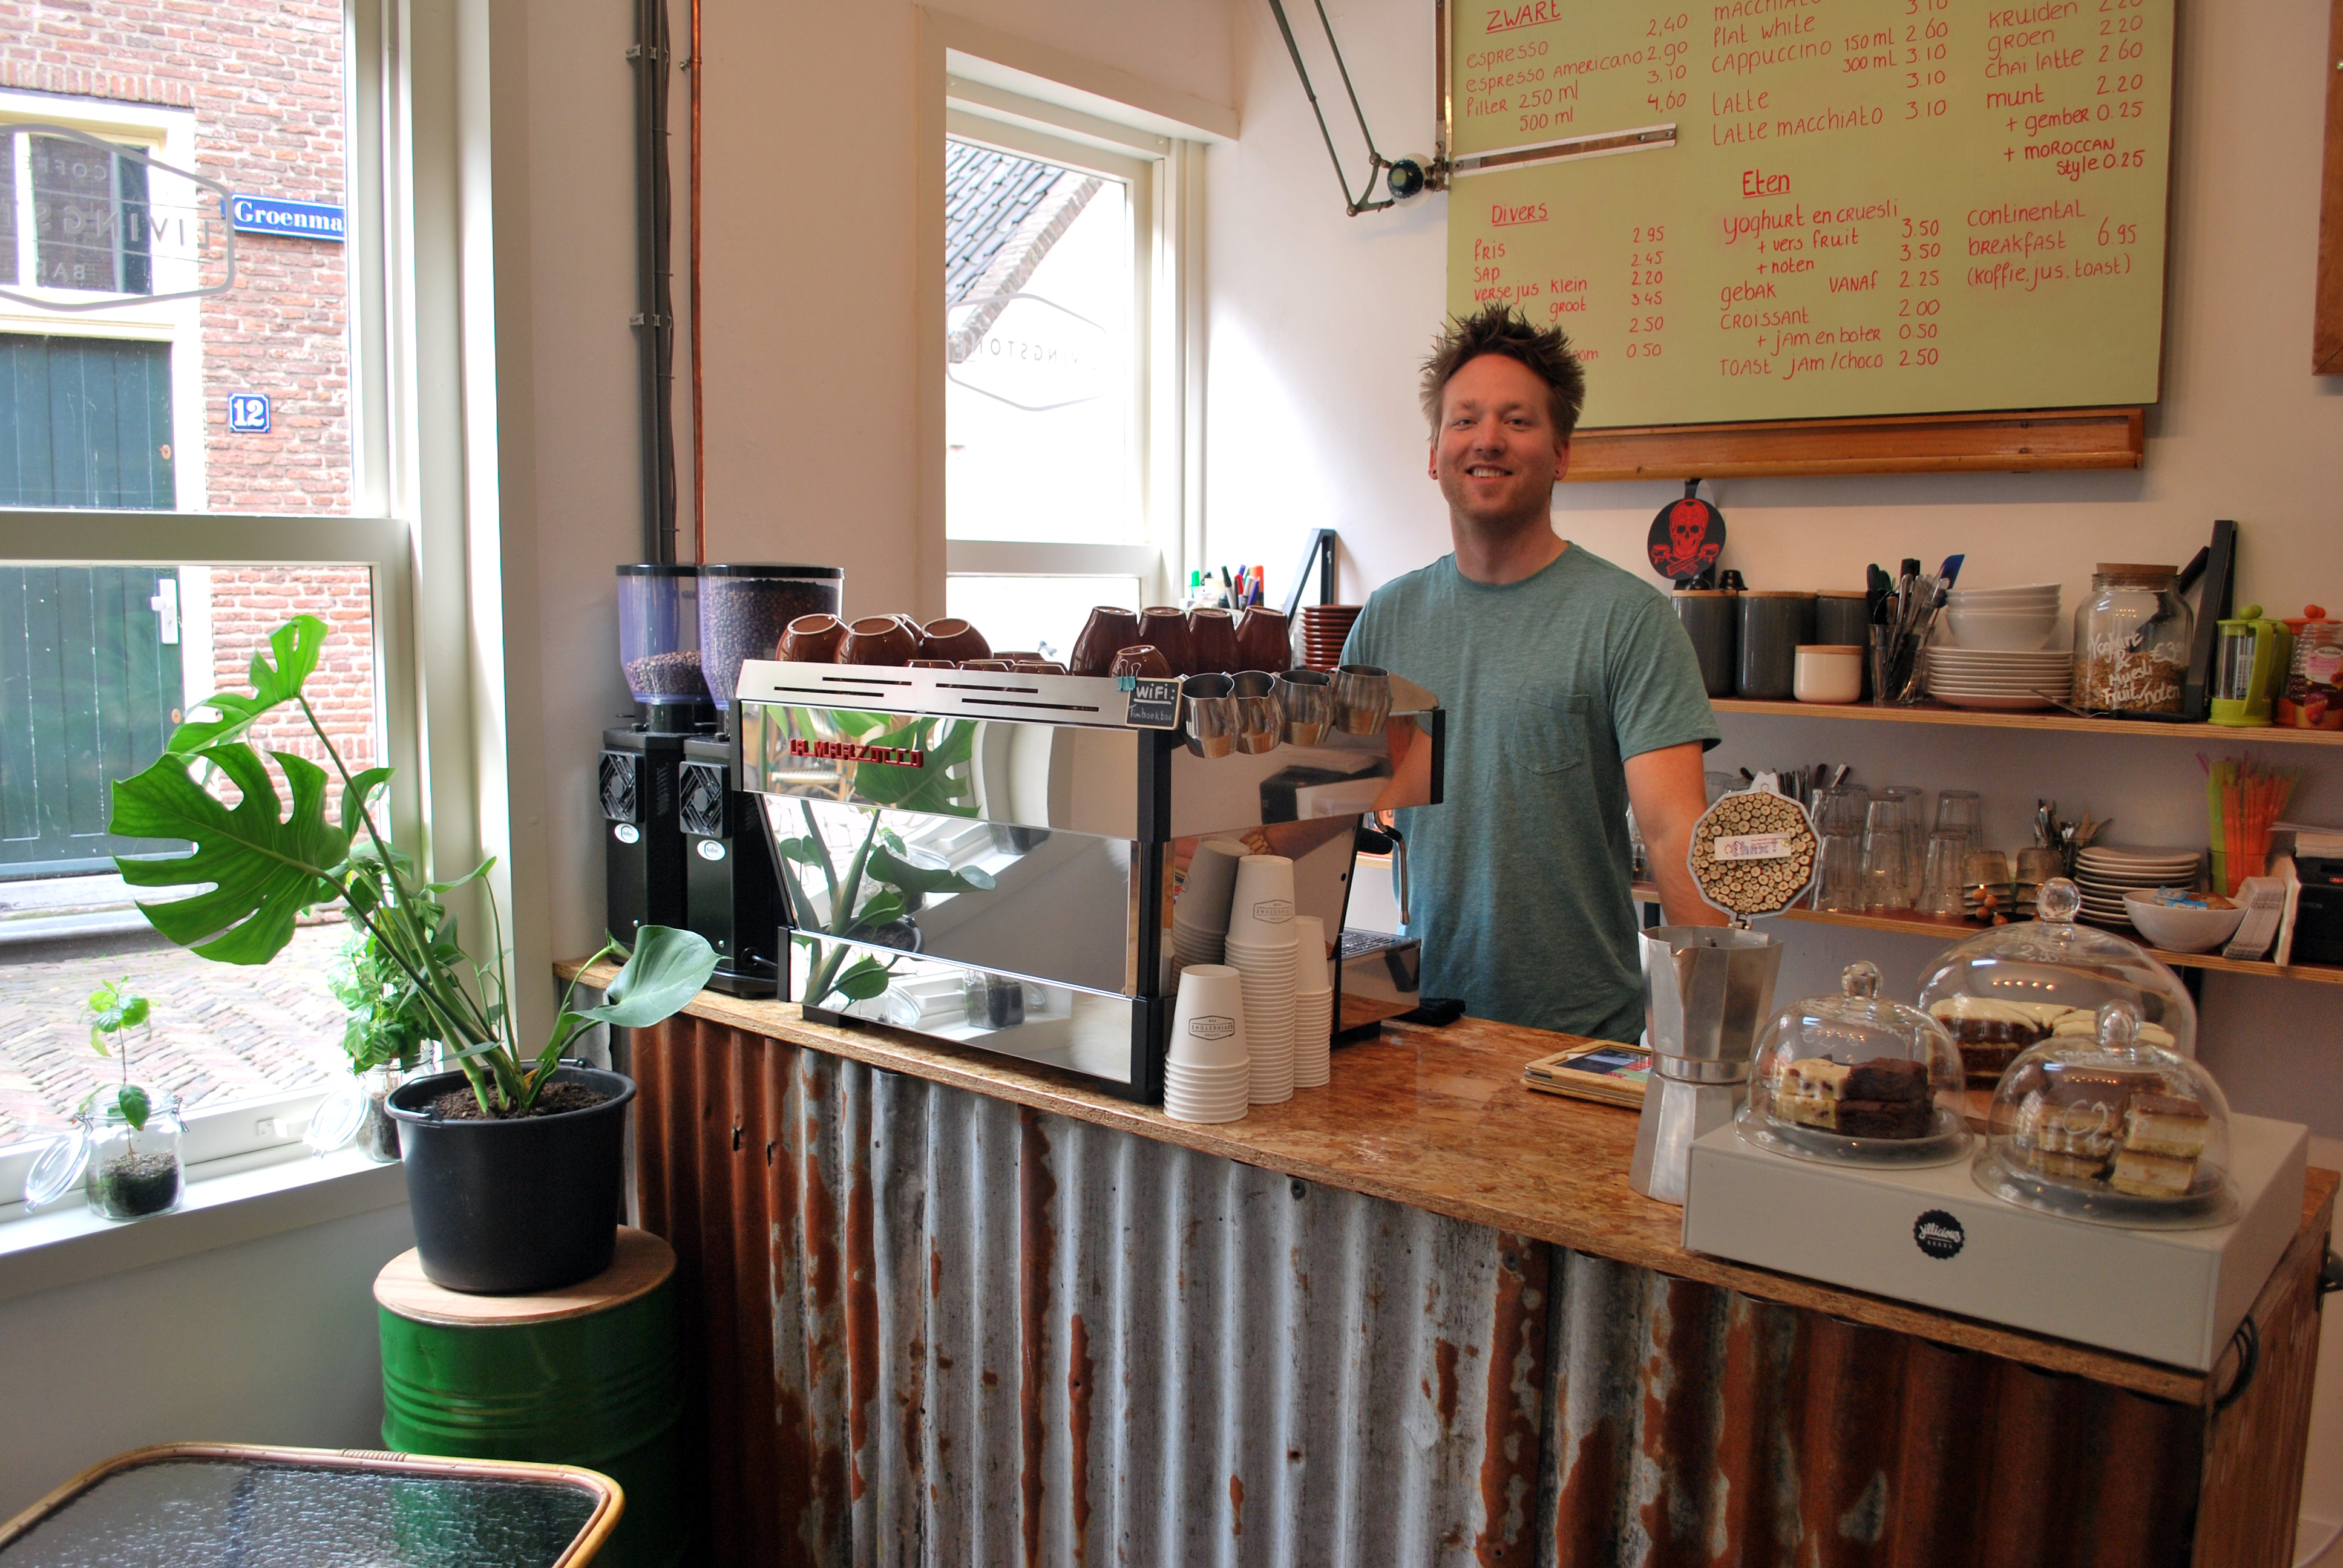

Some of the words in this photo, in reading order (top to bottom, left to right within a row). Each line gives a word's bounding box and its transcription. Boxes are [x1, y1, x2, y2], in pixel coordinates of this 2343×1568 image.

[1761, 15, 1816, 39] white
[1844, 34, 1870, 51] 150
[1906, 17, 1950, 43] 2.60
[2100, 15, 2143, 35] 2.20
[1647, 41, 1689, 67] 2.90
[1843, 56, 1869, 73] 300
[1907, 43, 1947, 64] 3.10
[2098, 39, 2143, 63] 2.60
[1519, 88, 1553, 109] 250
[1648, 64, 1687, 84] 3.10
[1907, 70, 1947, 90] 3.10
[1986, 83, 2045, 109] munt
[2096, 74, 2144, 96] 2.20
[1907, 99, 1948, 120] 3.10
[2097, 100, 2143, 122] 0.25
[1519, 113, 1549, 132] 500
[2102, 149, 2146, 170] 0.25
[1742, 169, 1791, 196] Eten
[1812, 209, 1833, 225] en
[1633, 225, 1665, 244] 2.95
[1773, 238, 1804, 252] vers
[1902, 217, 1941, 239] 3.50
[2097, 217, 2137, 246] 6.95
[1630, 250, 1664, 267] 2.45
[1771, 256, 1815, 274] noten
[1900, 242, 1942, 262] 3.50
[1899, 269, 1940, 289] 2.25
[1815, 330, 1836, 345] en
[1898, 322, 1938, 340] 0.50
[1626, 342, 1662, 359] 0.50
[1899, 347, 1940, 367] 2.50
[234, 399, 265, 428] 12
